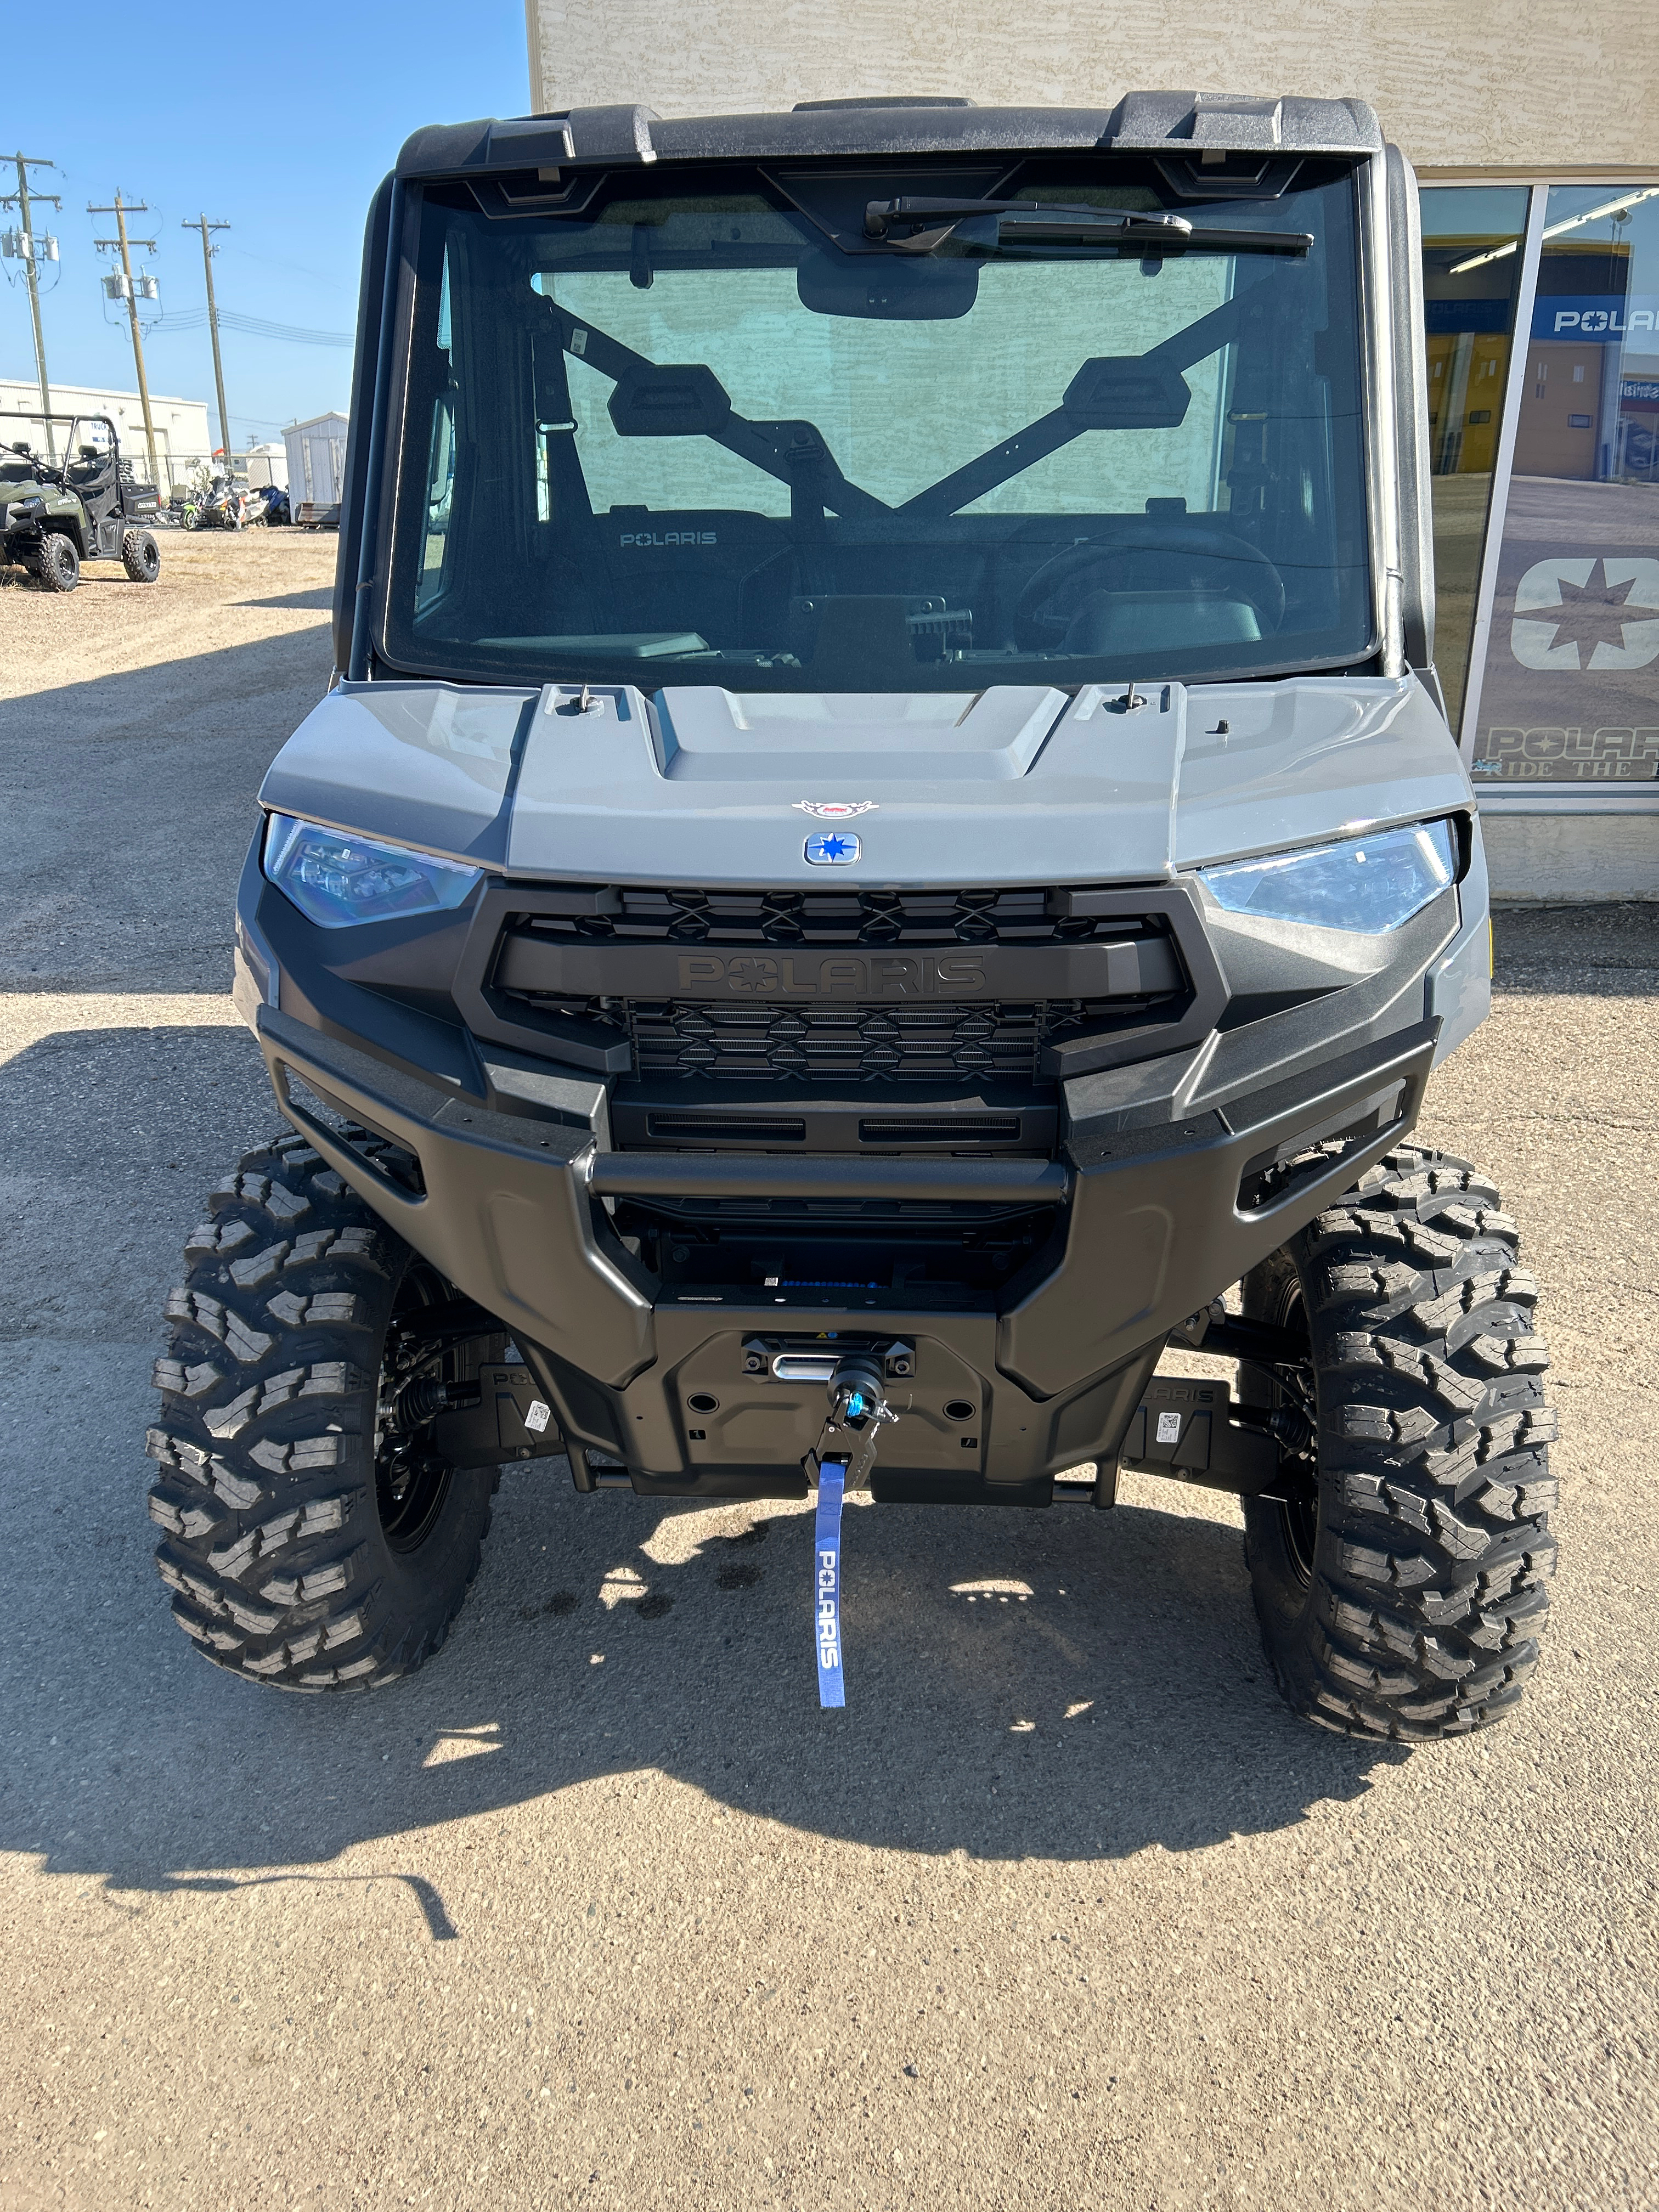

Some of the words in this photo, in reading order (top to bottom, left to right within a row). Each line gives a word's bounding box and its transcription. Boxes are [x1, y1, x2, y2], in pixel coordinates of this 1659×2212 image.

[1554, 311, 1659, 332] POLA
[620, 532, 717, 547] POLARIS
[1485, 761, 1553, 777] RIDE
[1572, 761, 1632, 777] THE
[678, 954, 987, 995] POLARIS
[819, 1550, 839, 1669] POLARIS
